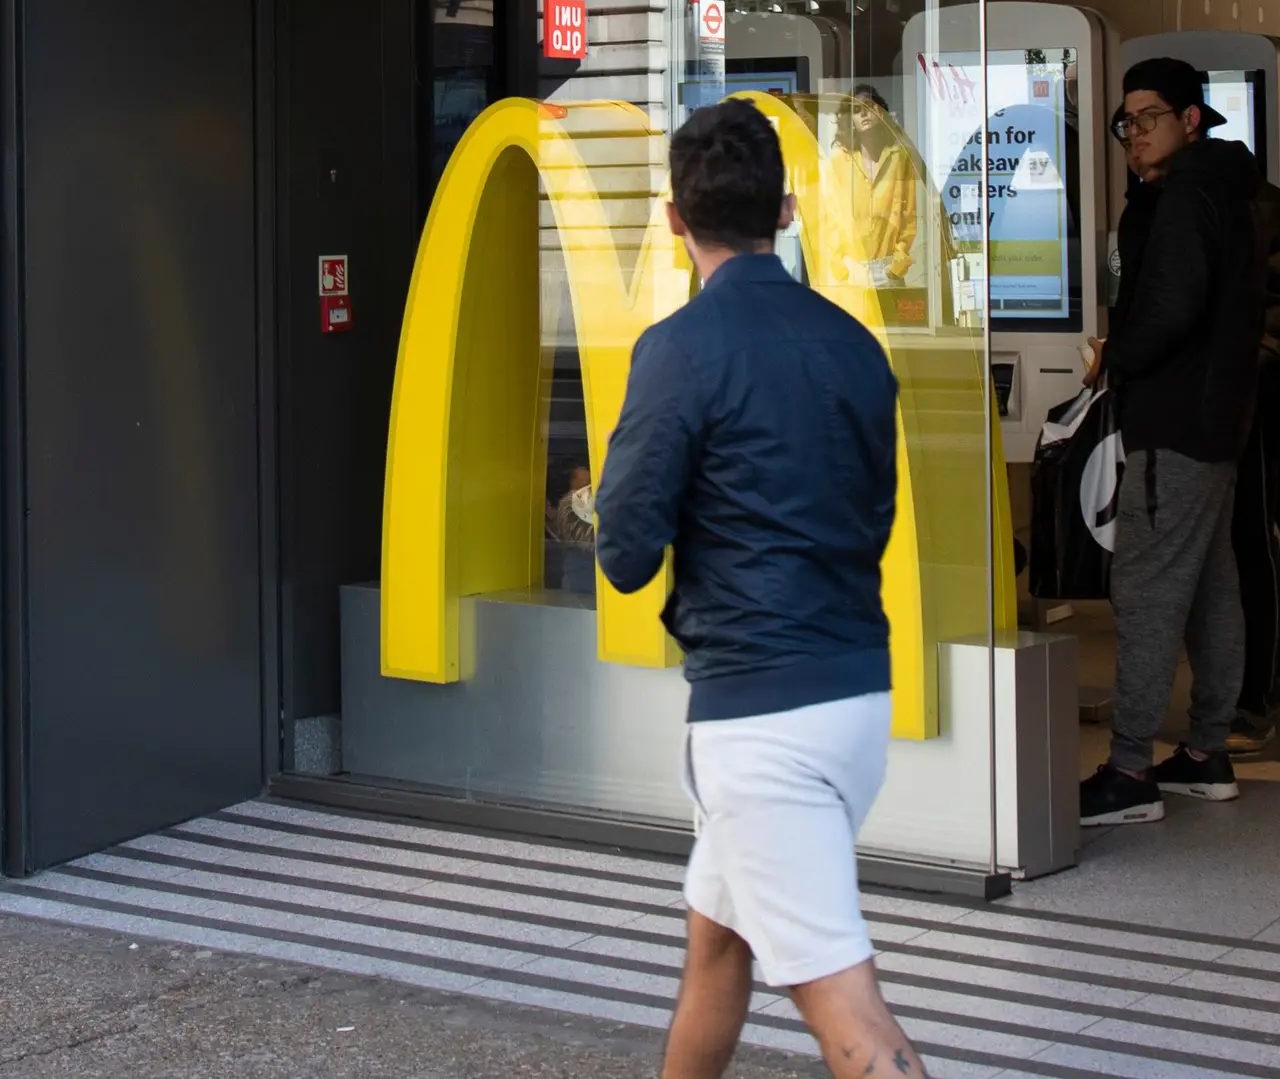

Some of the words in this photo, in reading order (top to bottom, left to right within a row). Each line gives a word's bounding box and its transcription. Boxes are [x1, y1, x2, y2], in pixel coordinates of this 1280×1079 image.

[1005, 126, 1036, 144] for
[949, 180, 1018, 199] oers
[949, 207, 995, 228] only
